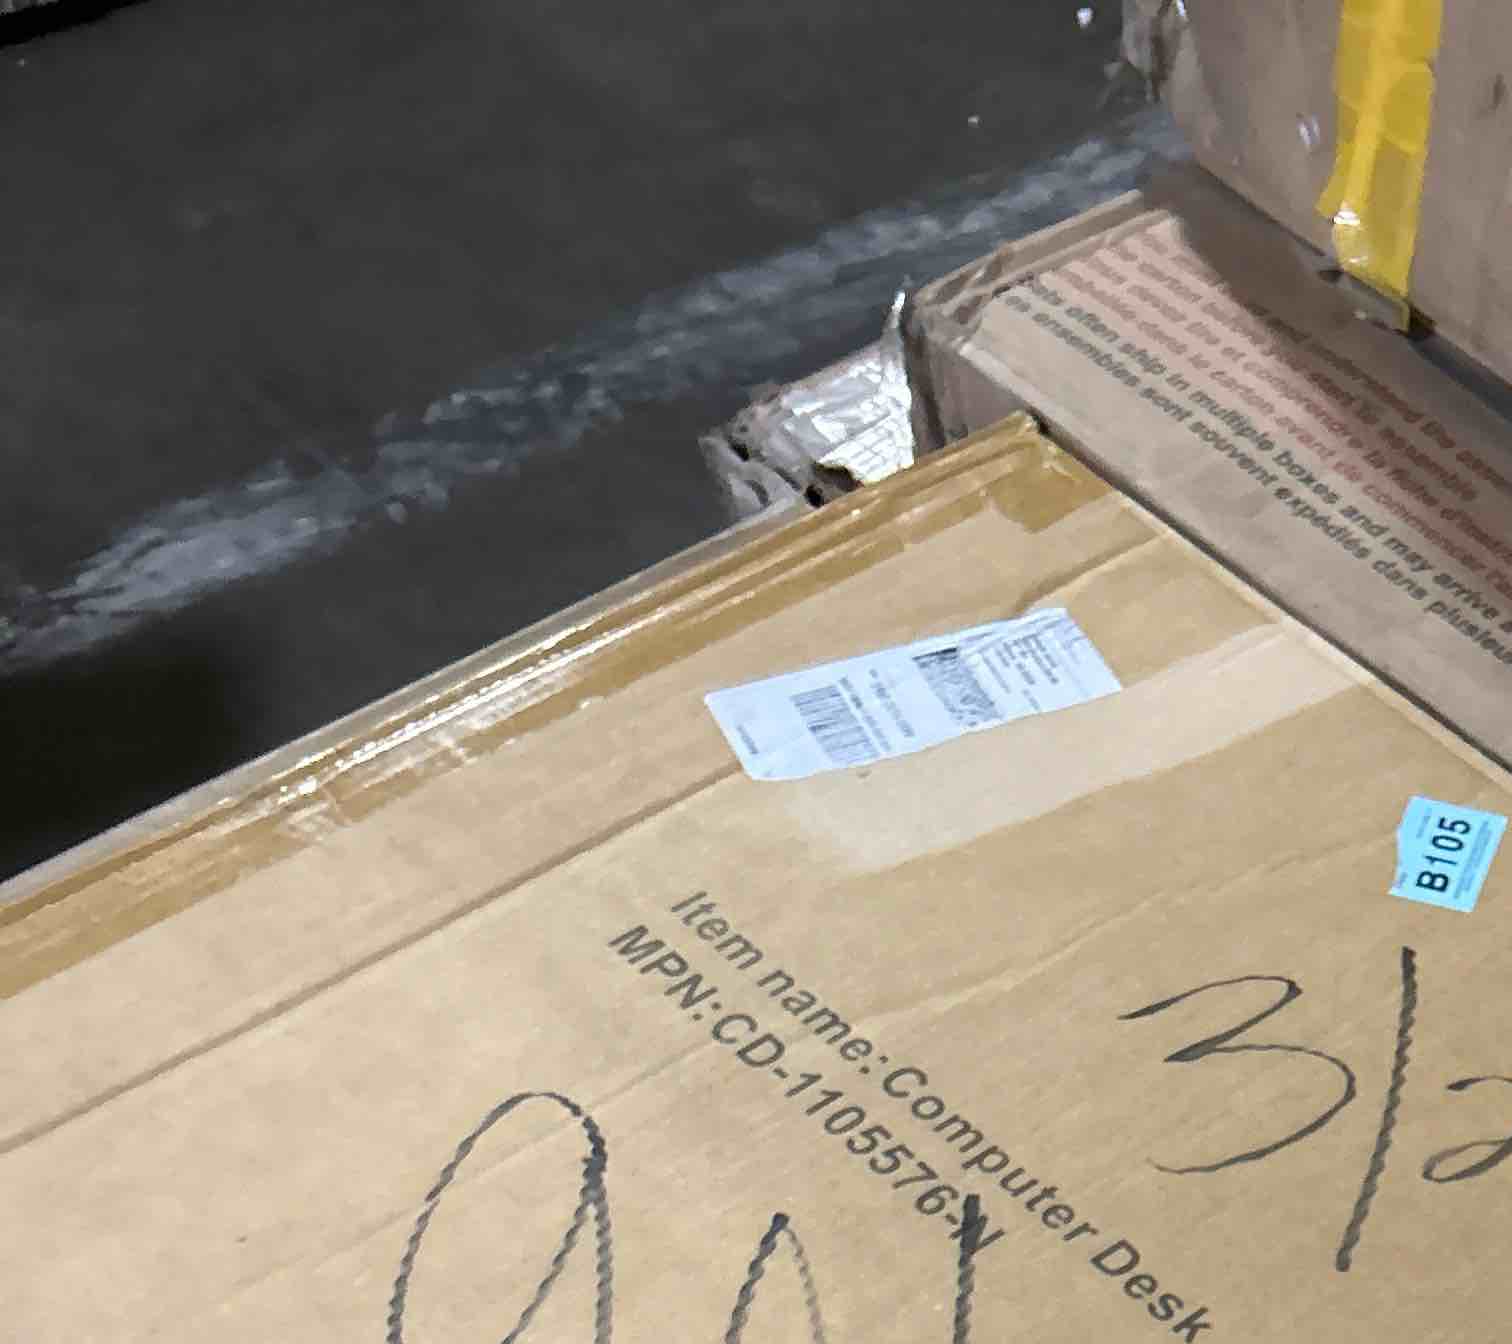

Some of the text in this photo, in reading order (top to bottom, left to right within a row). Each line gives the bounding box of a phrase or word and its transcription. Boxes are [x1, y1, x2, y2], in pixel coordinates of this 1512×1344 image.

[1031, 311, 1141, 387] ensembles
[1139, 386, 1193, 422] sont
[1187, 420, 1279, 486] souvent
[1372, 553, 1429, 603] dans
[1064, 305, 1120, 343] often
[1118, 341, 1168, 377] ship
[1165, 372, 1191, 392] in
[1188, 390, 1275, 452] multiple
[1272, 449, 1339, 504] boxes
[1340, 503, 1390, 537] and
[1383, 536, 1430, 575] may
[1433, 571, 1502, 623] arrive
[670, 889, 765, 970] Item
[1416, 816, 1472, 893] B105
